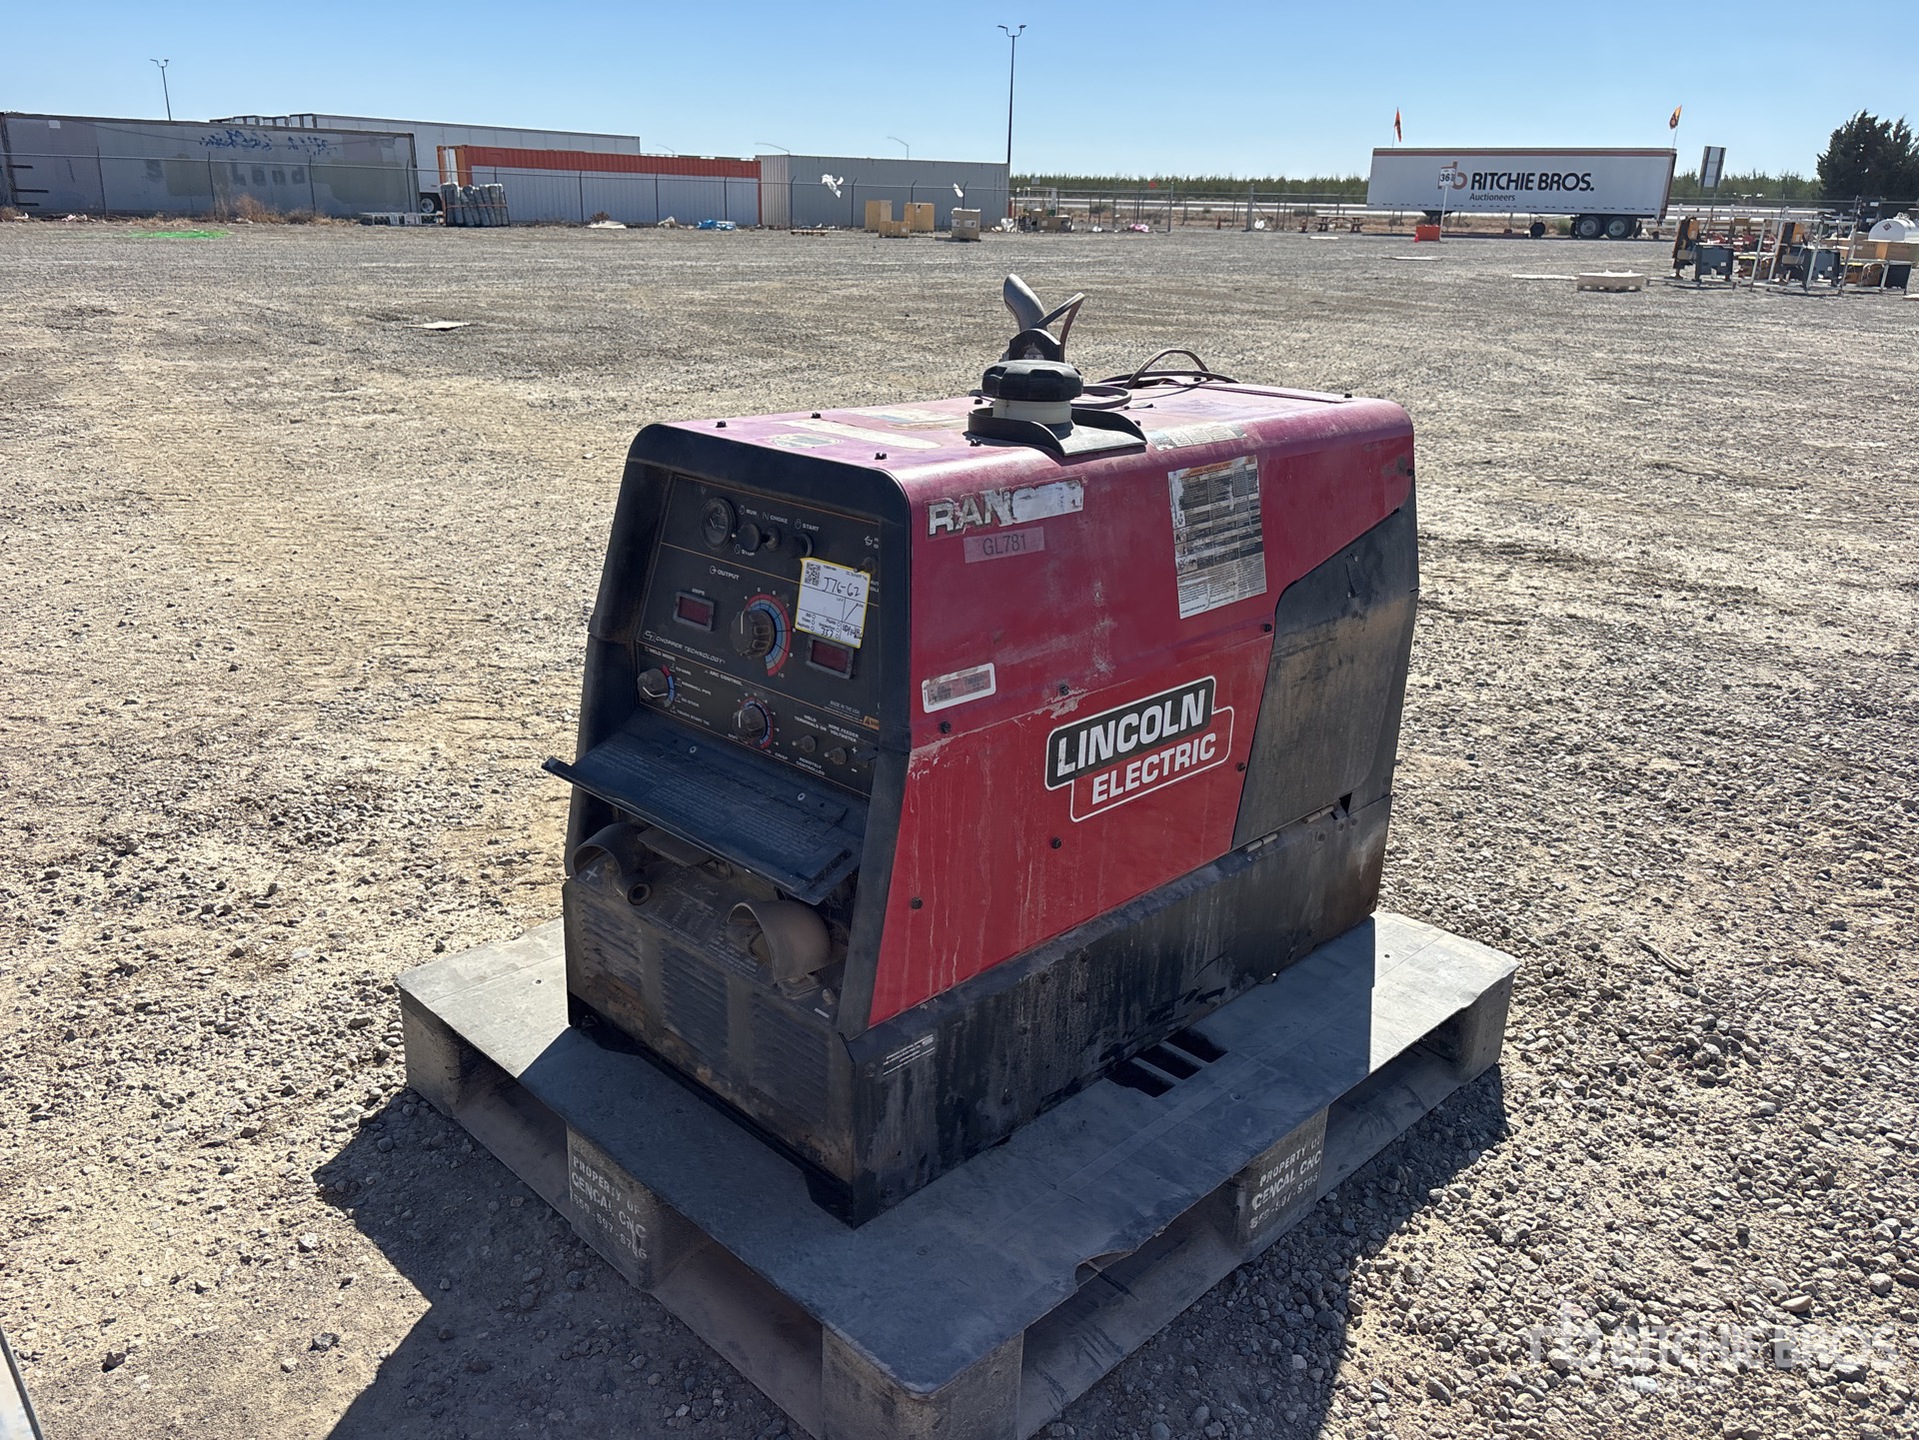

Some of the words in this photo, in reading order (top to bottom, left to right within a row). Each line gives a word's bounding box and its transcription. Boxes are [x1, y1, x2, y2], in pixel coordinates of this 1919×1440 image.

[1470, 172, 1536, 191] RITCHIE
[1537, 172, 1595, 192] BROS.
[1469, 193, 1516, 202] Auctioneers
[769, 514, 789, 525] CHOKE
[802, 523, 820, 532] START
[982, 534, 1027, 556] GL781
[717, 569, 740, 580] OUTPUT
[656, 636, 683, 649] CHOPPER
[709, 670, 720, 679] ARC
[720, 674, 743, 687] CONTROL
[830, 730, 857, 743] VOLTMETER
[840, 728, 860, 738] FEEDER
[1057, 688, 1206, 778] LINCOLN
[795, 760, 826, 776] CONTROLLED
[1091, 732, 1217, 806] ELECTRIC
[1259, 1145, 1307, 1188] PROPERTY
[572, 1155, 622, 1202] PROPERTY
[1252, 1169, 1296, 1211] CENCAL
[1299, 1150, 1322, 1175] CNC
[618, 1211, 648, 1239] CNC
